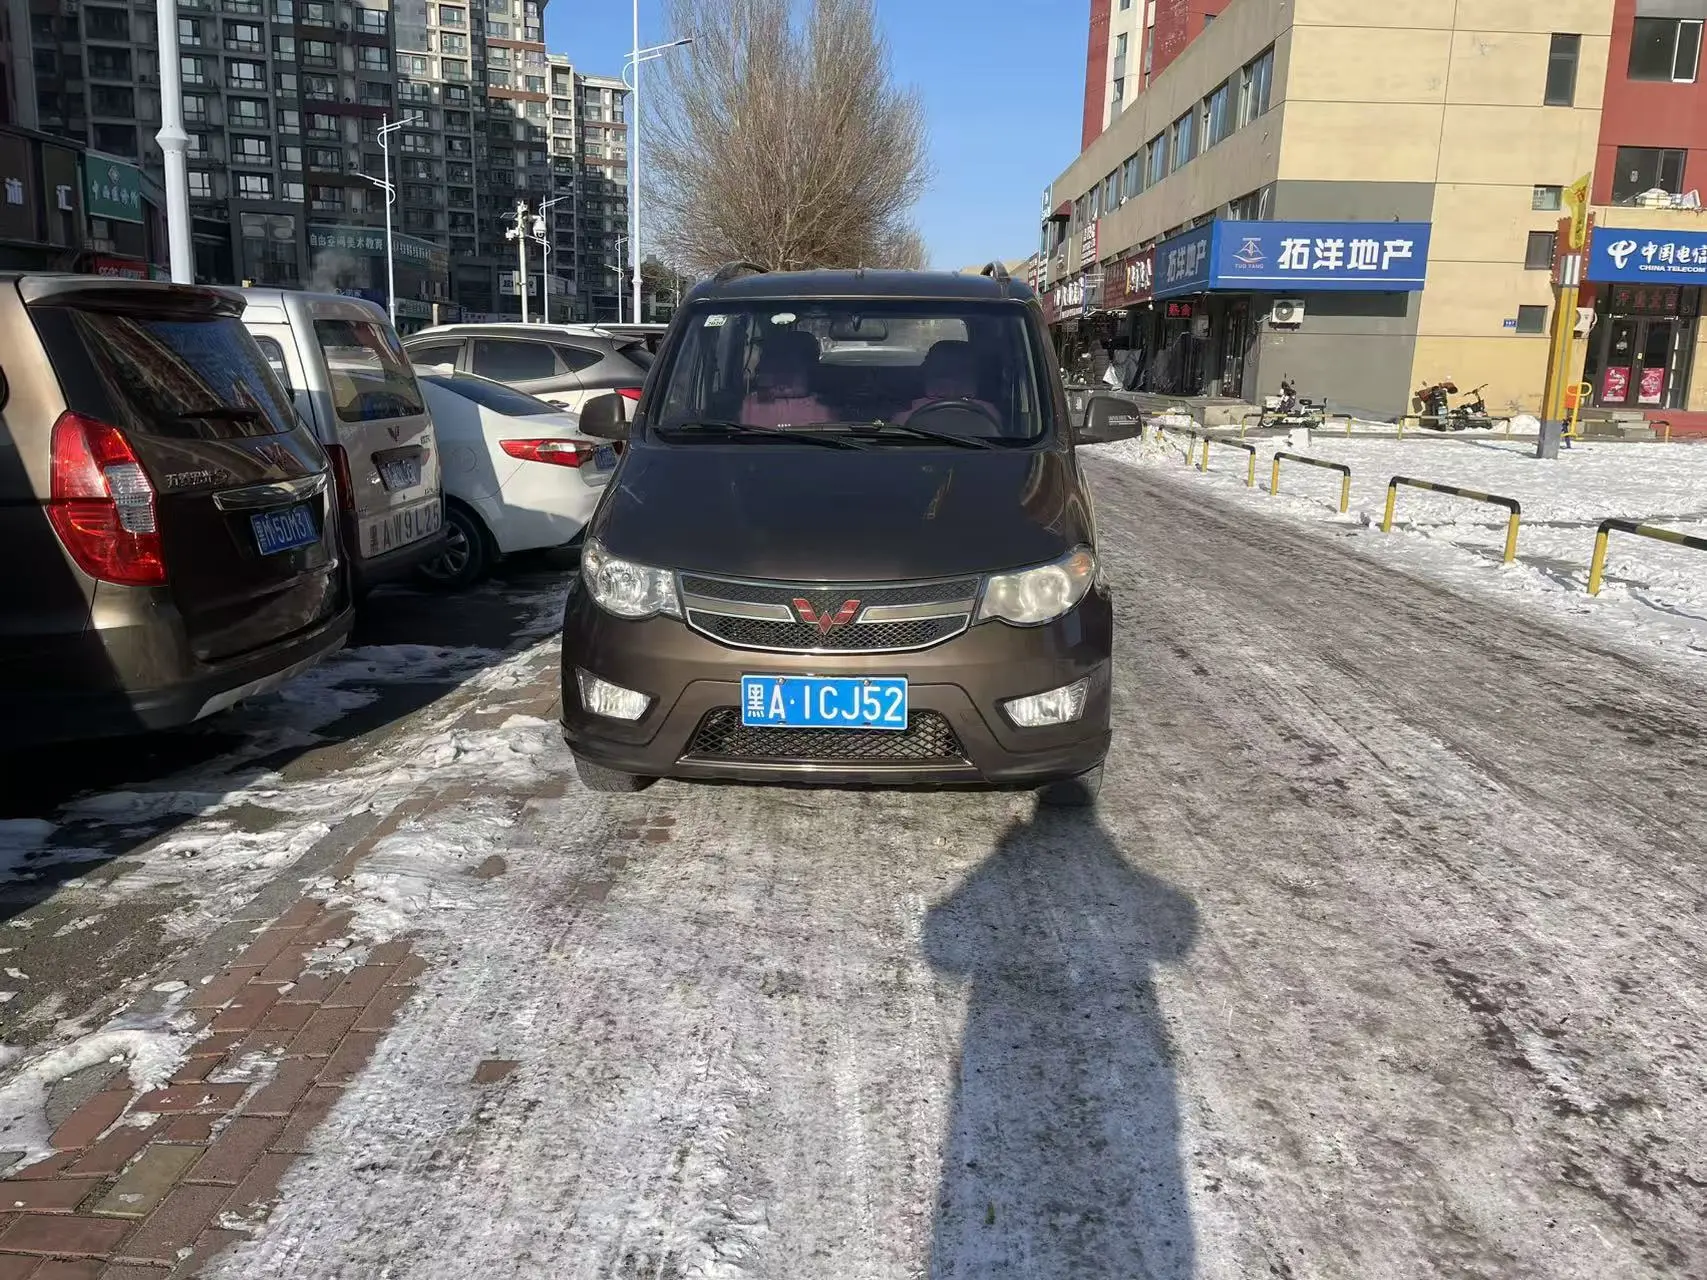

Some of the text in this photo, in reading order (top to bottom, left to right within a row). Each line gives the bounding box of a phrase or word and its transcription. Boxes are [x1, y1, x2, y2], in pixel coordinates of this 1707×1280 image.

[1277, 238, 1414, 271] 拓洋地产
[1640, 240, 1707, 265] 中国电信
[1638, 264, 1706, 273] CHINA TELECOM
